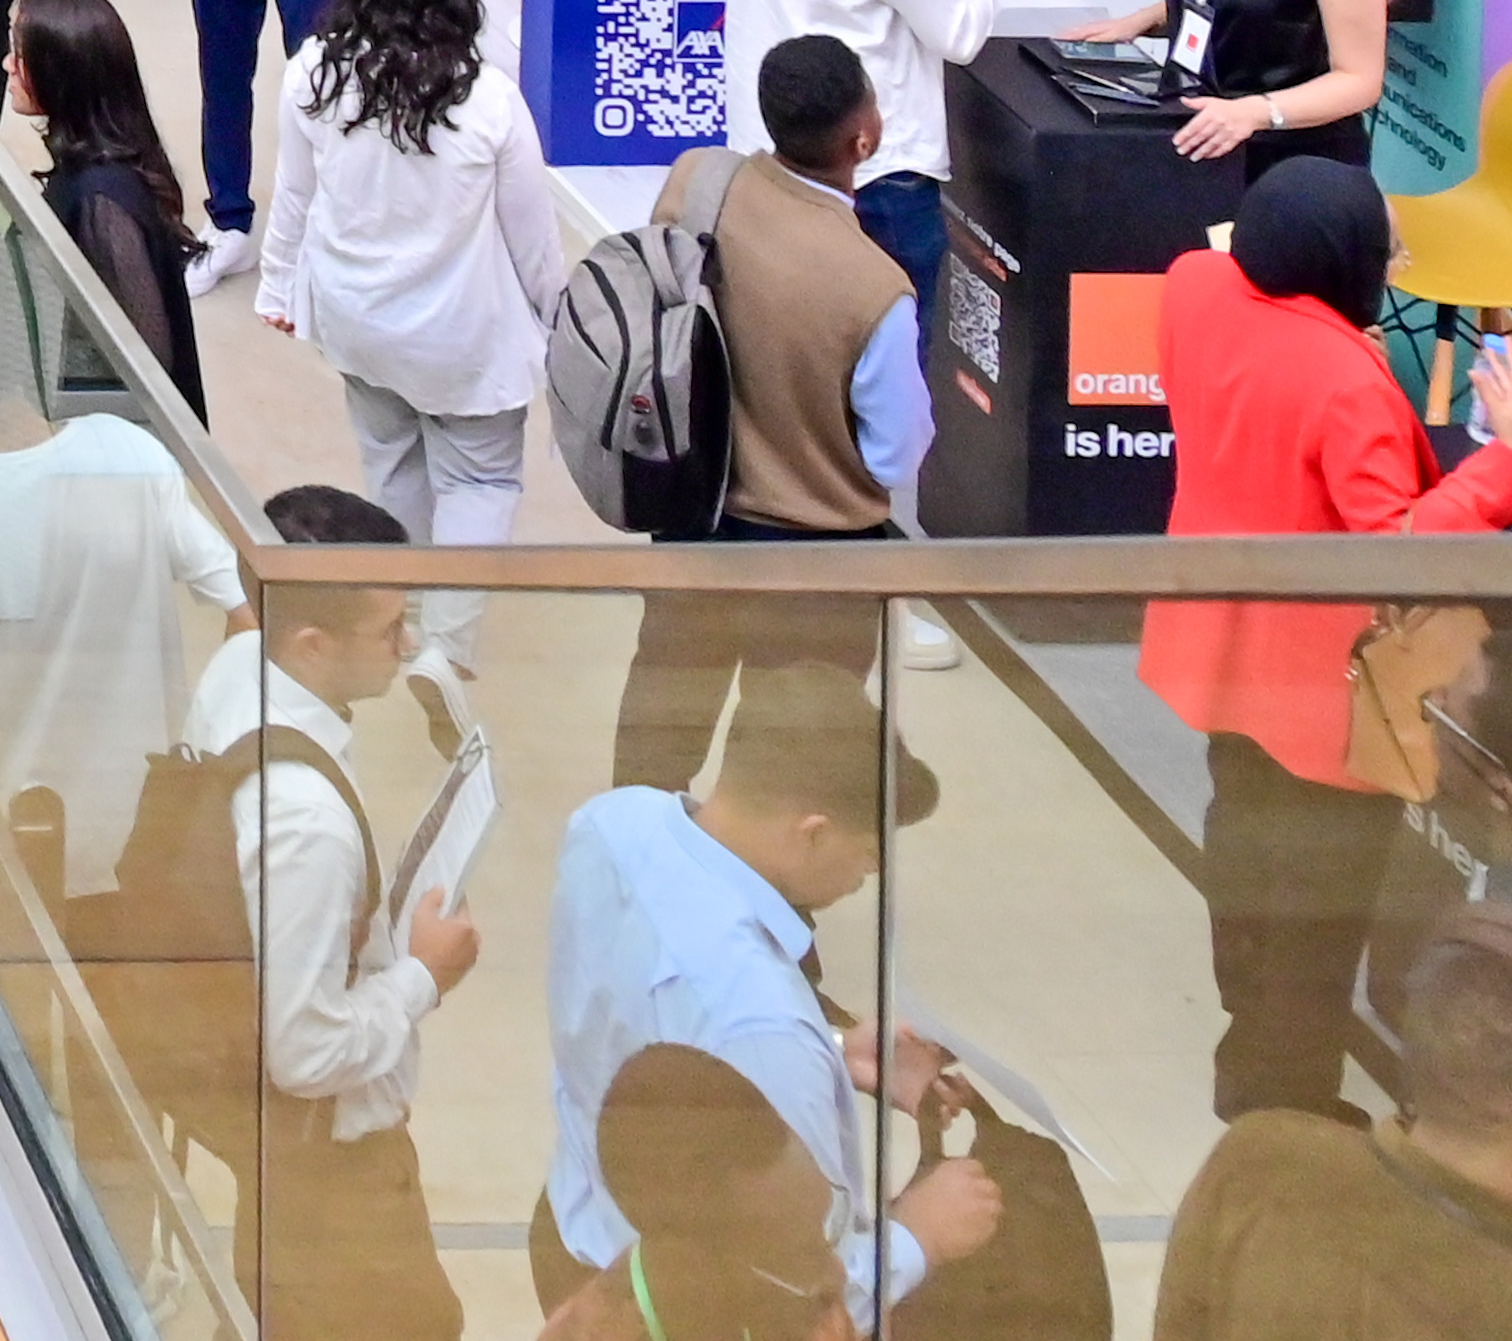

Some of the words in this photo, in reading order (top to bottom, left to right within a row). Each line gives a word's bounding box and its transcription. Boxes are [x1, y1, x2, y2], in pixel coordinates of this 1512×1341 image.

[1075, 372, 1167, 401] orang
[1064, 423, 1101, 457] is
[1107, 423, 1176, 457] her
